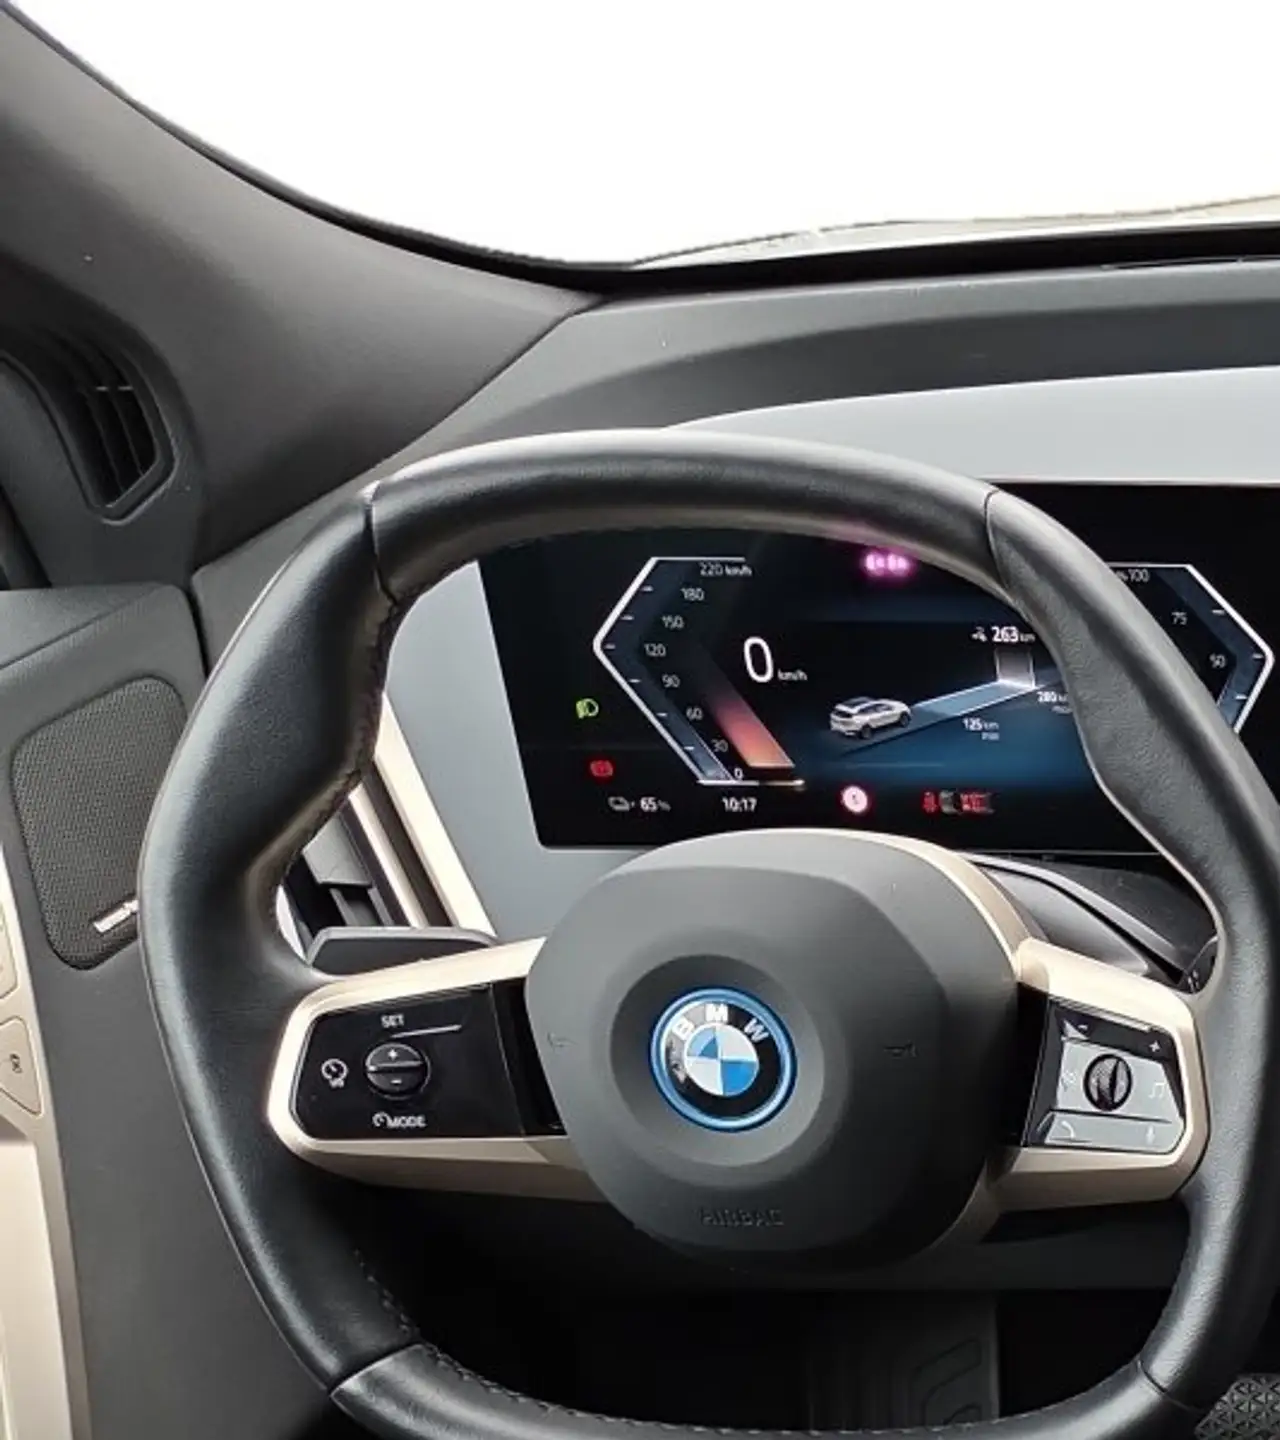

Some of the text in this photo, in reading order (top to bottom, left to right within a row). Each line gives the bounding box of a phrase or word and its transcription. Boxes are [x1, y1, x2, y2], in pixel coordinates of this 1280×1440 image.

[699, 562, 723, 577] 220
[1127, 568, 1151, 583] 100
[680, 587, 706, 602] 180
[661, 614, 685, 630] 150
[1171, 611, 1189, 626] 75
[990, 625, 1020, 644] 263
[643, 642, 668, 658] 120
[743, 635, 775, 684] 0
[1208, 653, 1228, 669] 50
[661, 673, 681, 689] 90
[685, 707, 704, 722] 60
[710, 738, 729, 753] 30
[733, 767, 744, 781] 0
[721, 797, 758, 813] 10:17
[381, 1013, 405, 1029] SET
[671, 1002, 770, 1043] BMW
[386, 1114, 428, 1129] MODE
